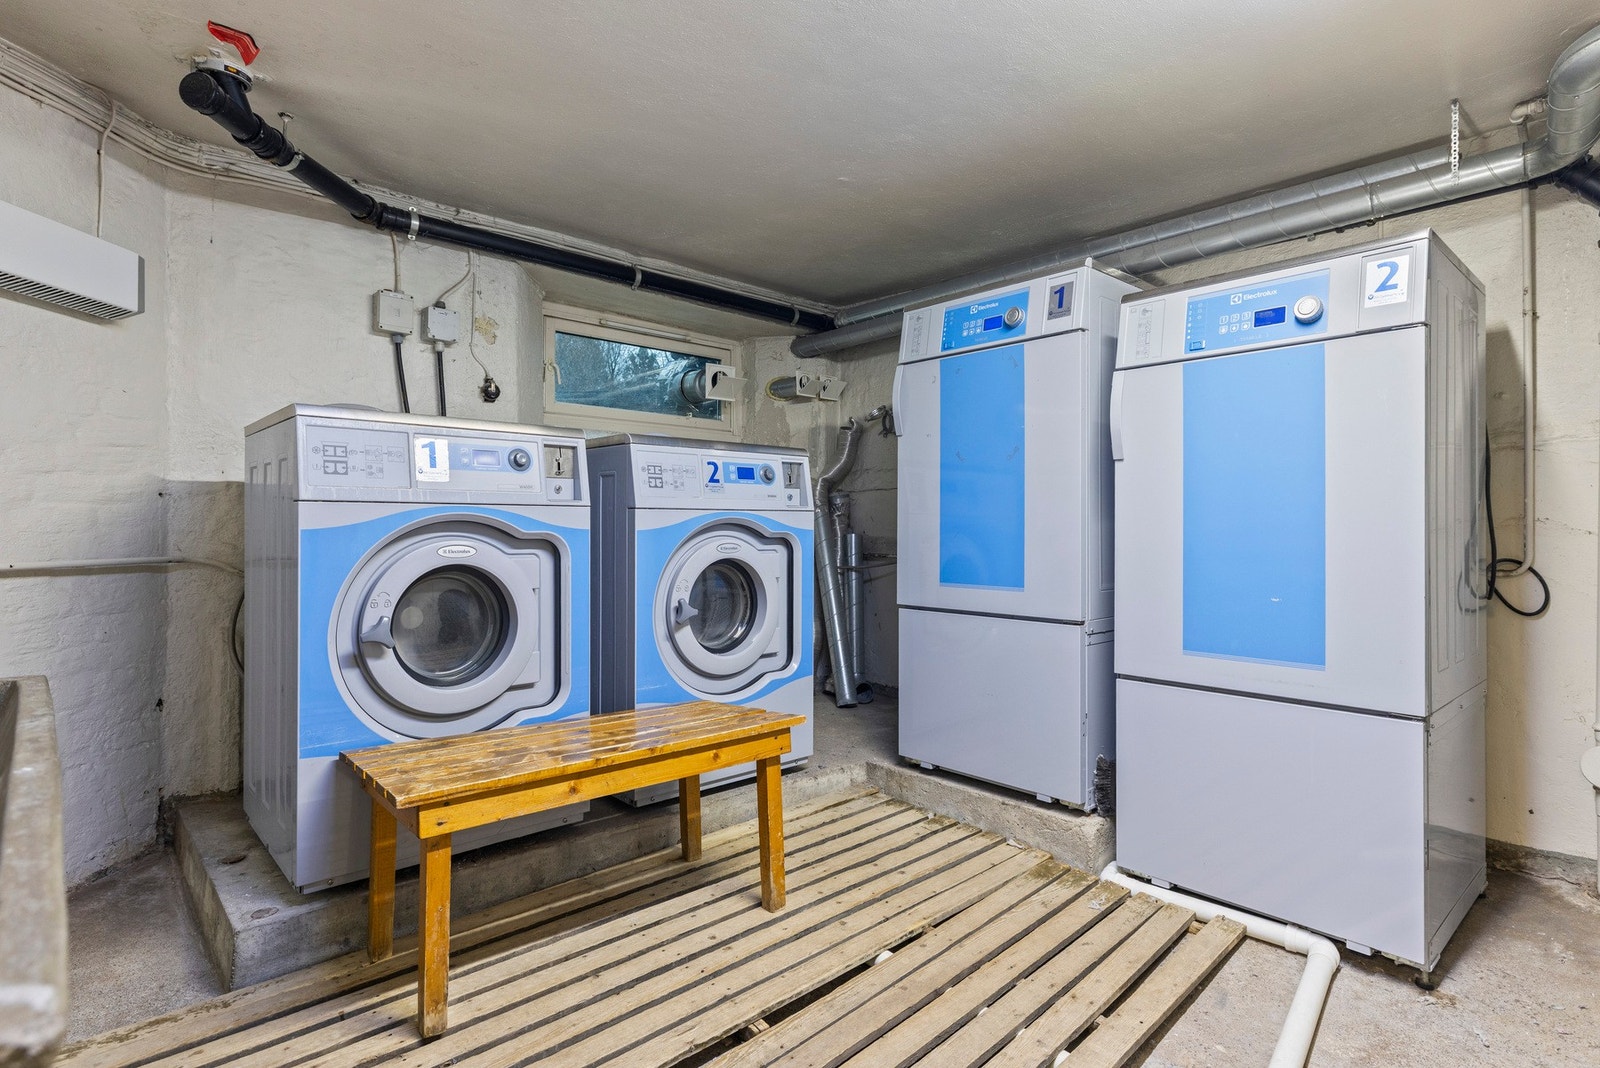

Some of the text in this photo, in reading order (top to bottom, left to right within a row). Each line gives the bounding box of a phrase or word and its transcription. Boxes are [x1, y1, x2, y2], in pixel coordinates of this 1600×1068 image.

[1374, 260, 1400, 293] 2
[1053, 286, 1065, 309] 1
[1243, 289, 1278, 301] Electrolux
[421, 441, 437, 468] 1
[706, 461, 720, 483] 2
